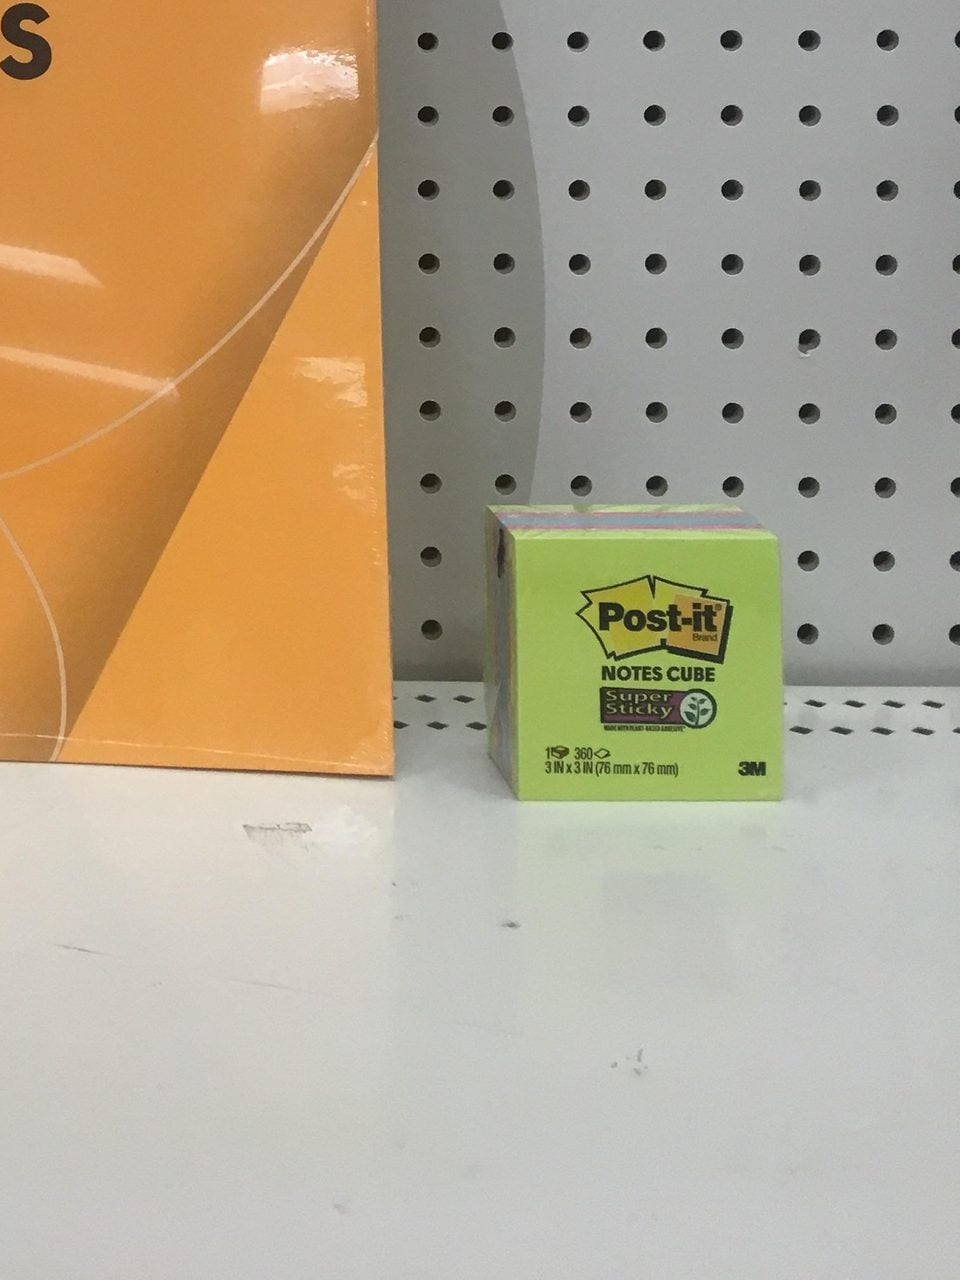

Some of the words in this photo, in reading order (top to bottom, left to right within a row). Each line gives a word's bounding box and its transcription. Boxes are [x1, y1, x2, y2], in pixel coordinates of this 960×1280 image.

[691, 632, 719, 643] Brand
[601, 665, 663, 682] NOTES
[666, 665, 716, 682] CUBE
[605, 689, 673, 705] Super
[605, 702, 674, 719] Sticky
[574, 747, 593, 760] 360
[545, 761, 551, 774] 3
[553, 761, 565, 774] IN
[566, 764, 573, 774] x
[574, 761, 581, 774] 3
[583, 761, 593, 774] IN
[595, 762, 611, 777] (76
[613, 764, 632, 775] mm
[633, 765, 640, 775] x
[642, 762, 655, 775] 76
[657, 762, 679, 778] mm)
[738, 761, 767, 777] 3M
